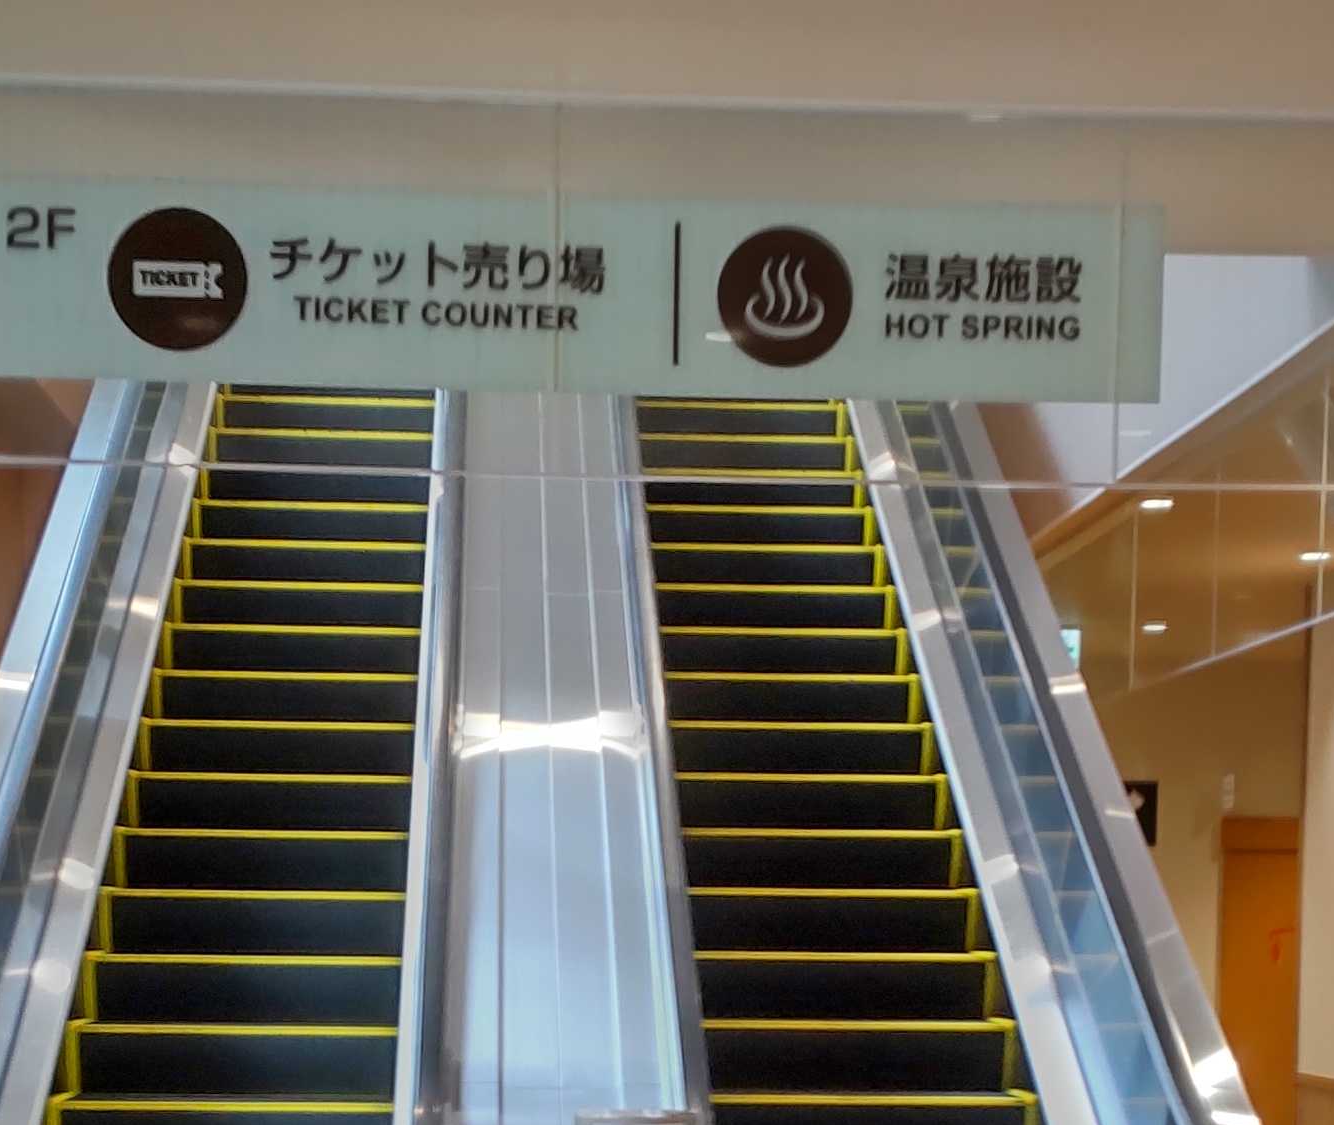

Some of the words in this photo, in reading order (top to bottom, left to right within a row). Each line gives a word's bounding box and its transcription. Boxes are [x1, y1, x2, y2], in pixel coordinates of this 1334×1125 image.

[6, 206, 77, 249] 2F
[139, 268, 200, 287] TICKET
[269, 237, 605, 295] チケット売り場
[884, 253, 1083, 303] 温泉施設
[293, 295, 410, 324] TICKET
[421, 300, 579, 330] COUNTER
[884, 313, 950, 340] HOT
[961, 314, 1081, 341] SPRING
